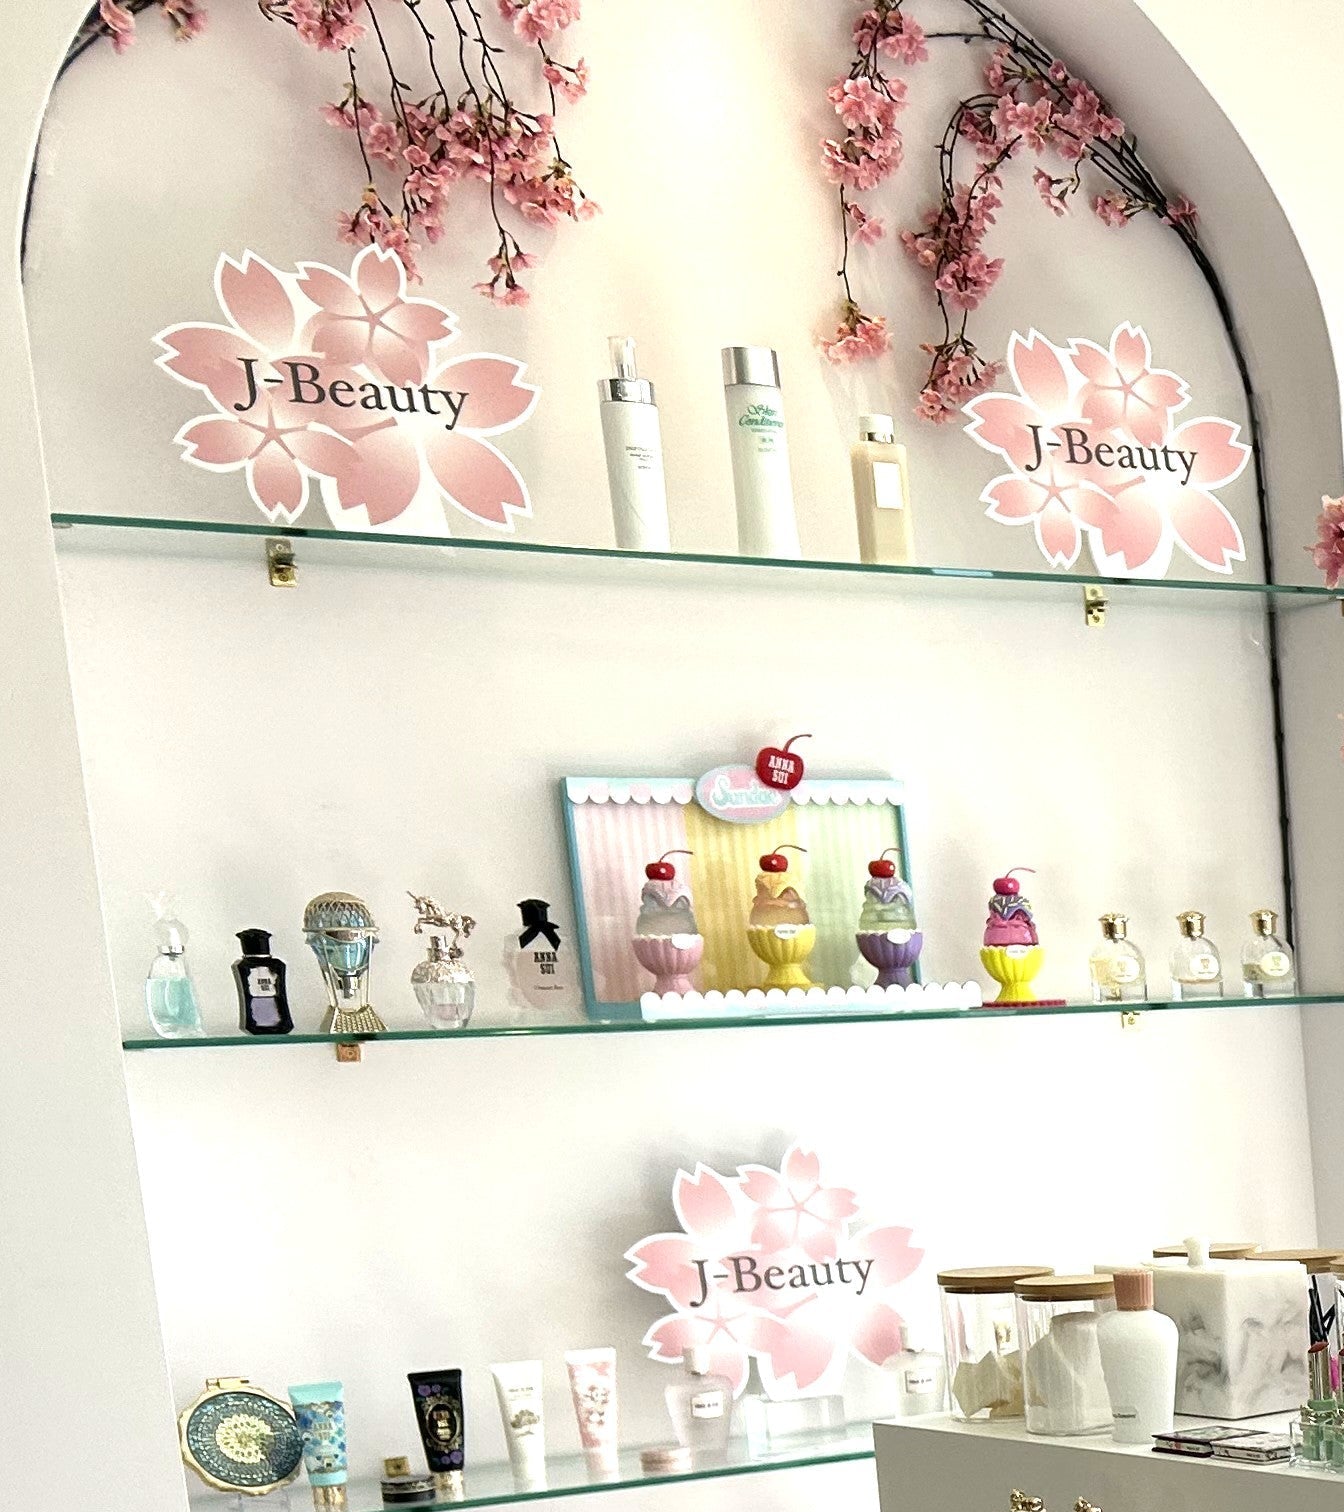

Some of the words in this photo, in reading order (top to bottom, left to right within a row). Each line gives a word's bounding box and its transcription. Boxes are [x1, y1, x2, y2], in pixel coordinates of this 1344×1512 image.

[233, 357, 470, 431] J-Beauty
[1025, 424, 1199, 486] J-Beauty
[768, 755, 795, 774] ANNA
[690, 1256, 875, 1308] J-Beauty
